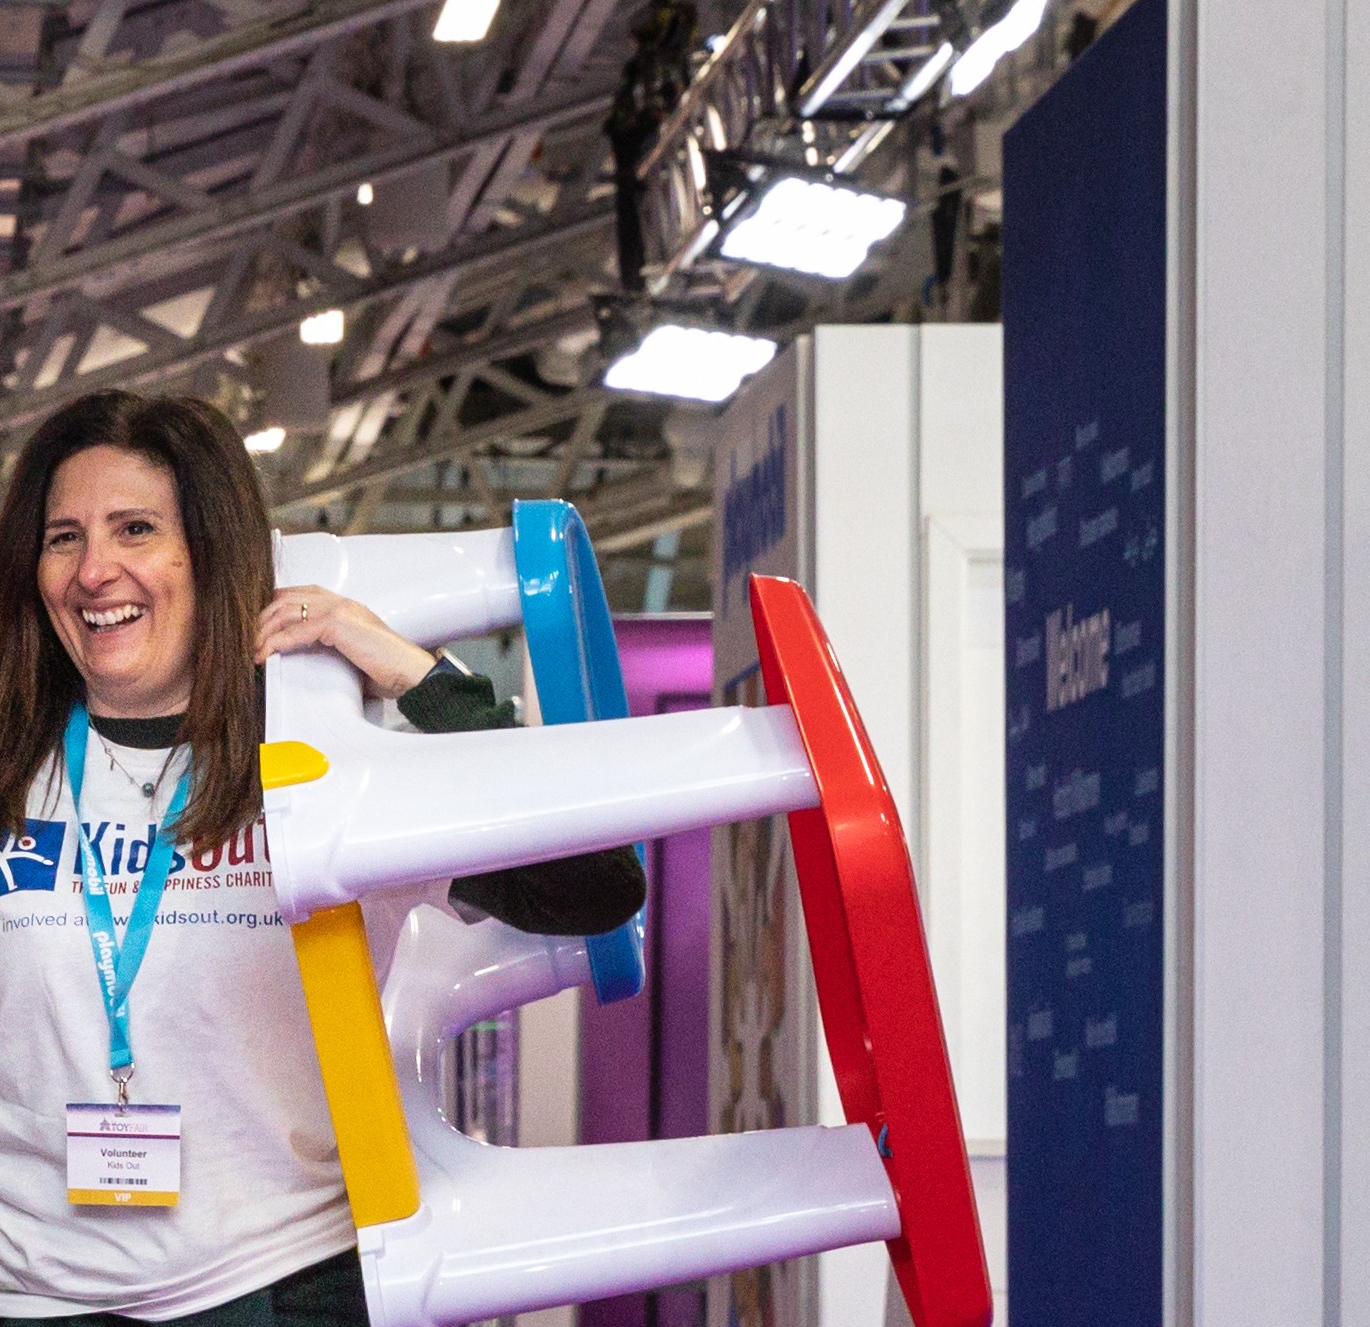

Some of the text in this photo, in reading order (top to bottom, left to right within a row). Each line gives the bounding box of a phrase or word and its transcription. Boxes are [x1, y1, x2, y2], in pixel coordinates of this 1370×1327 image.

[163, 878, 222, 892] PPINESS
[225, 871, 272, 887] CHARIT
[2, 911, 68, 932] involved
[100, 1148, 147, 1158] Volunteer
[114, 1192, 132, 1202] VIP
